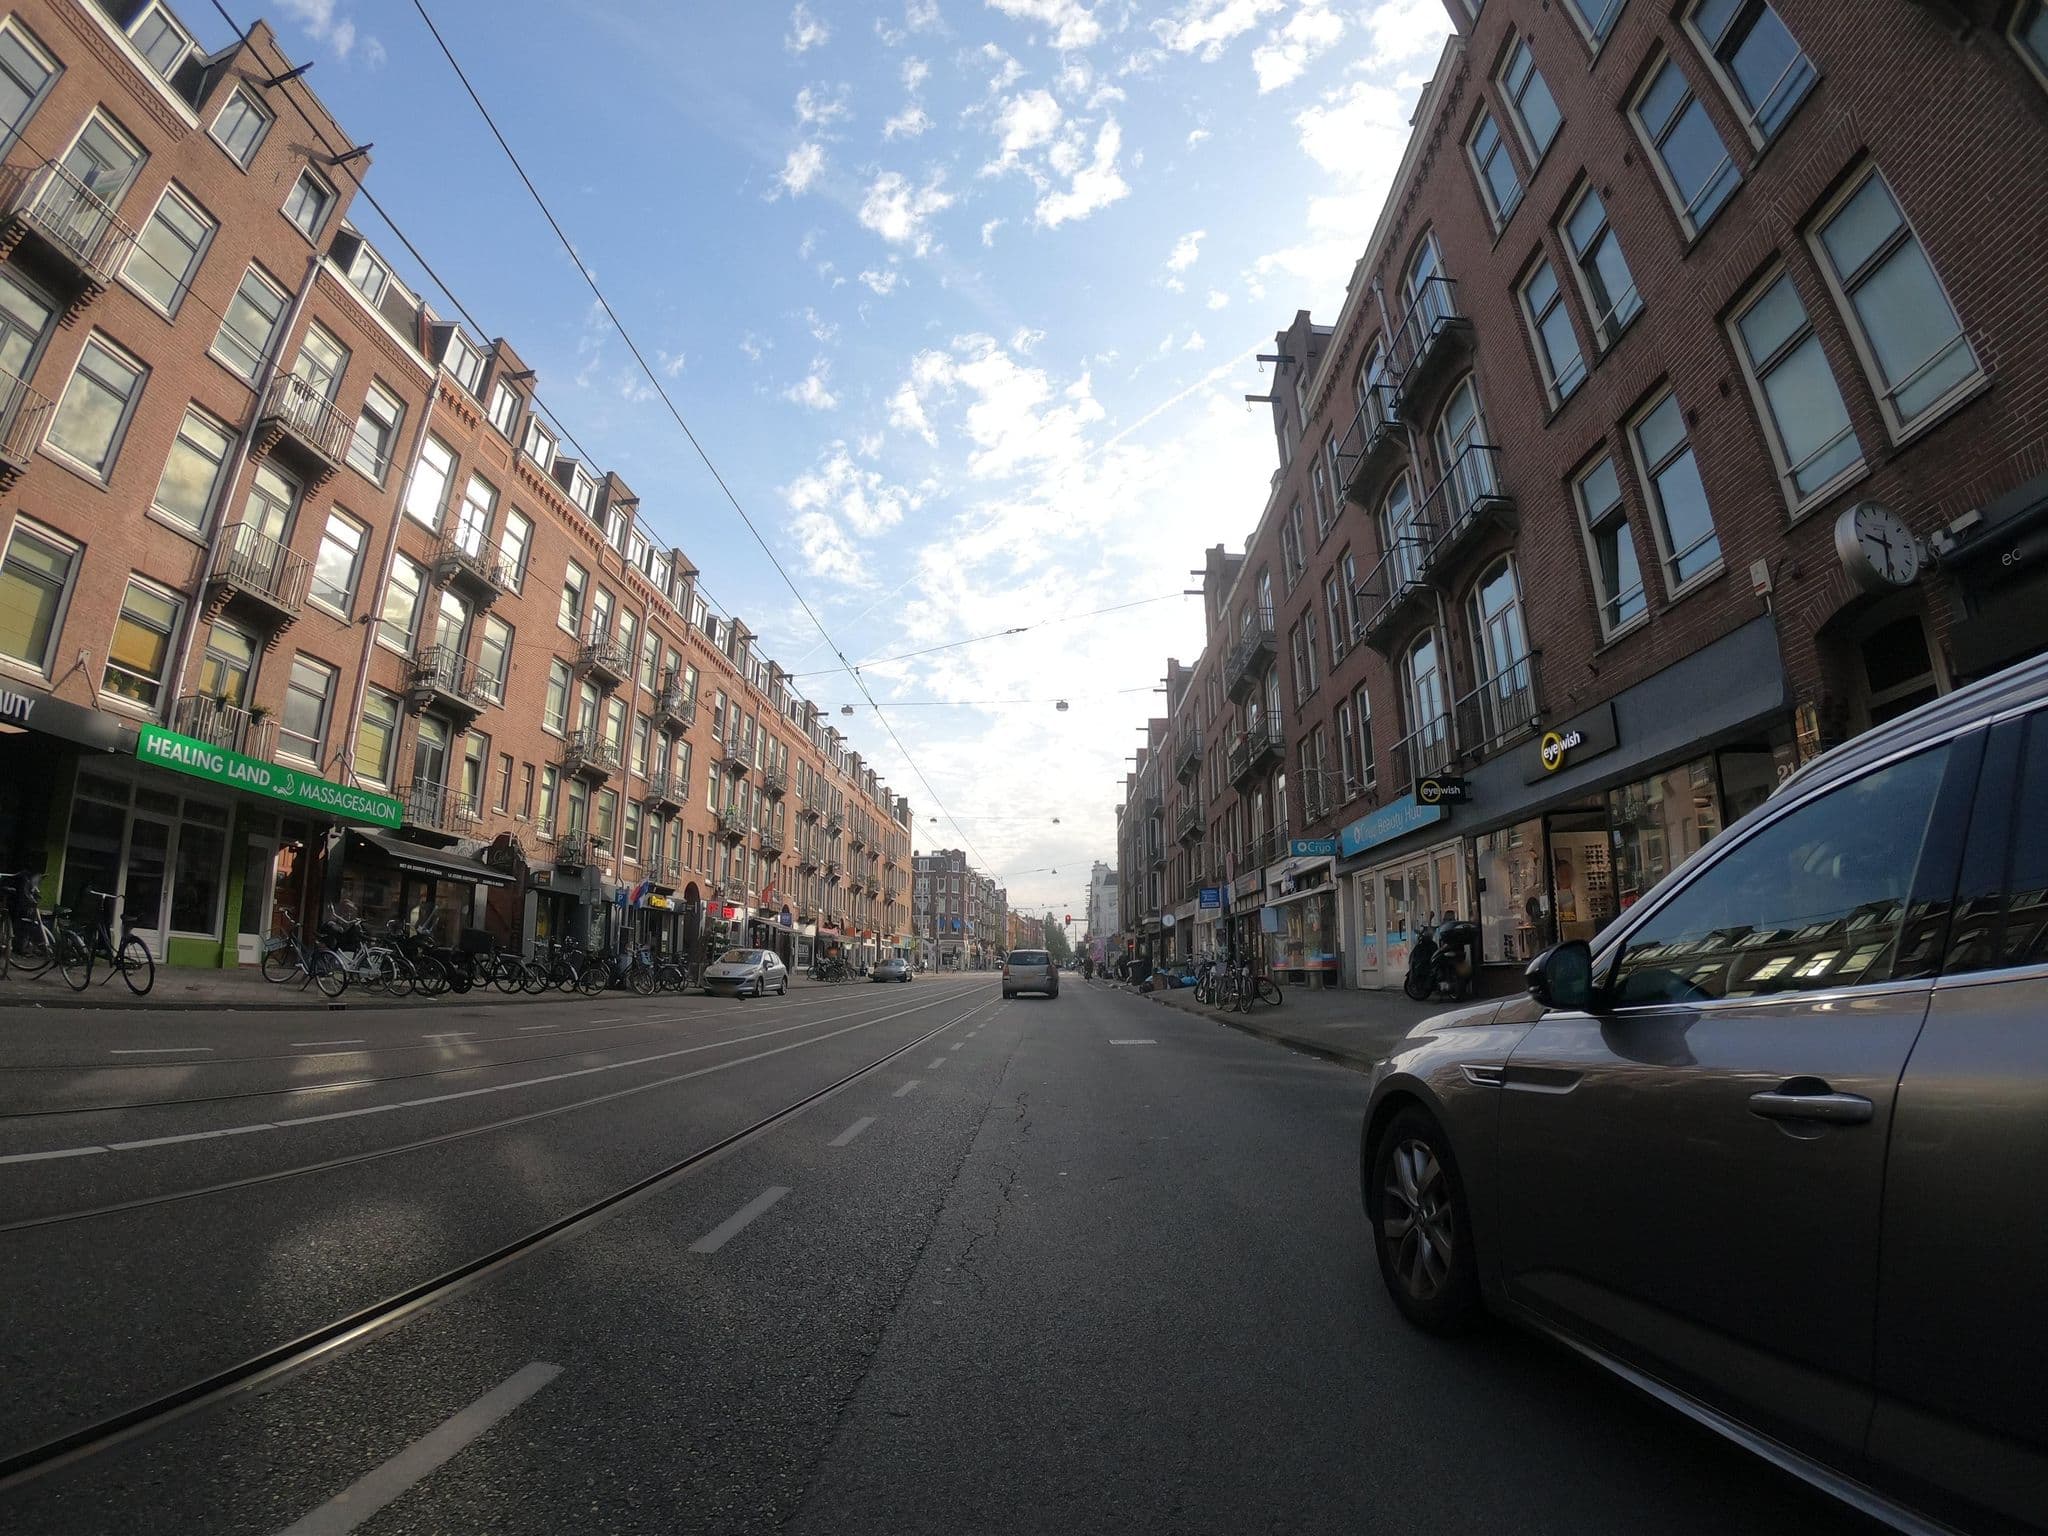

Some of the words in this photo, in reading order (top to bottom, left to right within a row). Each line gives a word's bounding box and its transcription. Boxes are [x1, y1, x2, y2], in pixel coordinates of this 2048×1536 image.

[0, 688, 36, 721] UTY
[146, 734, 225, 773] HEALING
[228, 759, 271, 786] LAND
[298, 781, 396, 820] MASSAGESALON
[1307, 841, 1331, 854] Cryo
